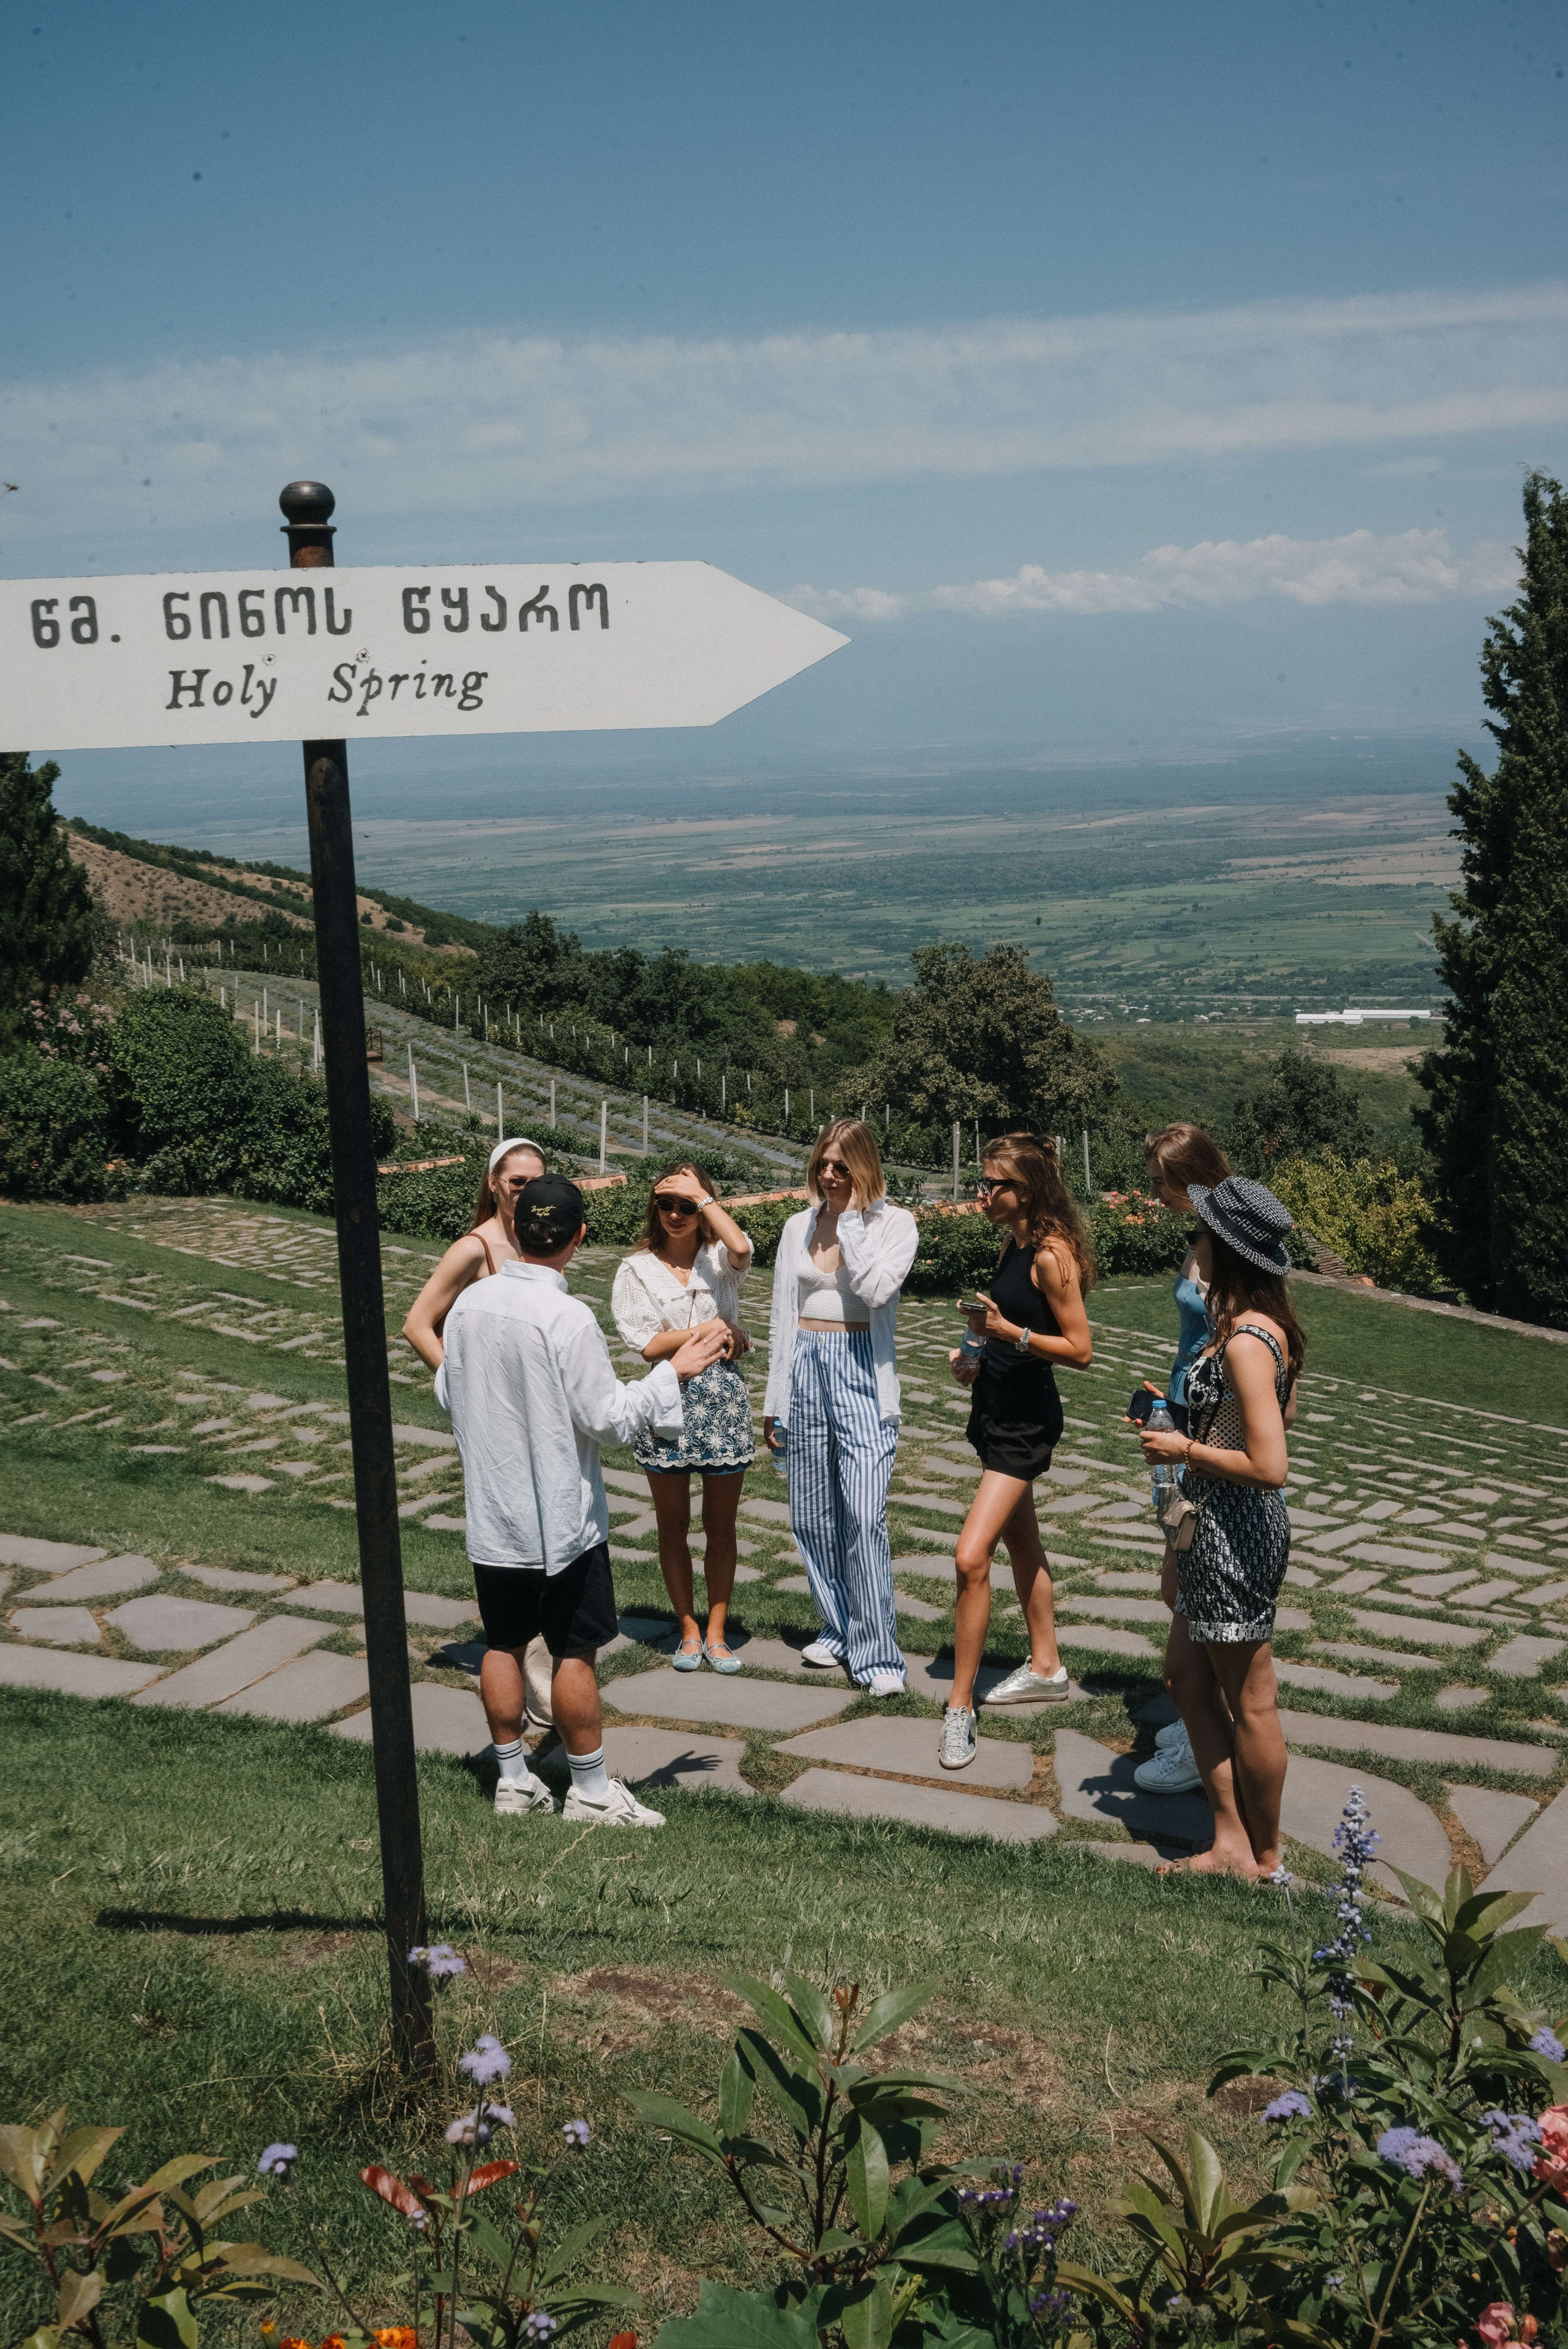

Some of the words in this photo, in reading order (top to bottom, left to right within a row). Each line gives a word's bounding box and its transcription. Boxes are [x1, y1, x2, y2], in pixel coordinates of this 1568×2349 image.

[31, 595, 121, 649] წმ.
[162, 586, 352, 641] ნინოს
[402, 583, 609, 635] წყარო
[165, 663, 277, 719] Holy
[328, 660, 489, 717] Spring
